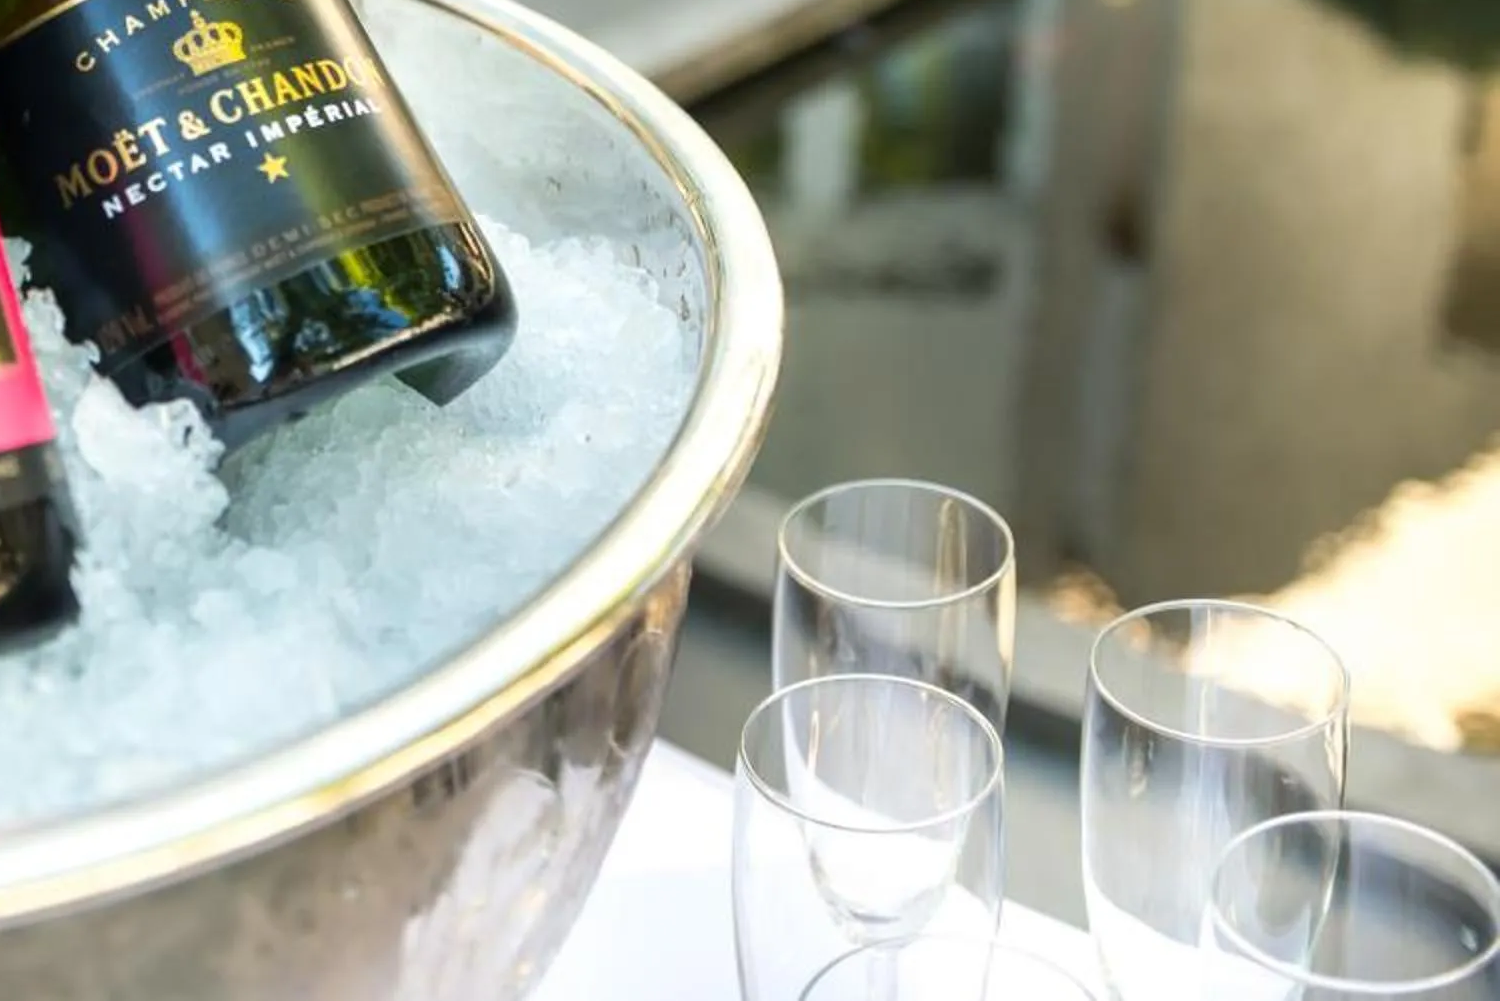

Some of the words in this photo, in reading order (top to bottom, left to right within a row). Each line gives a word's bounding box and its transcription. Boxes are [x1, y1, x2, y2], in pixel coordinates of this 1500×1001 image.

[54, 118, 177, 209] MOËT
[178, 109, 211, 142] &
[102, 142, 232, 219] NECTAR
